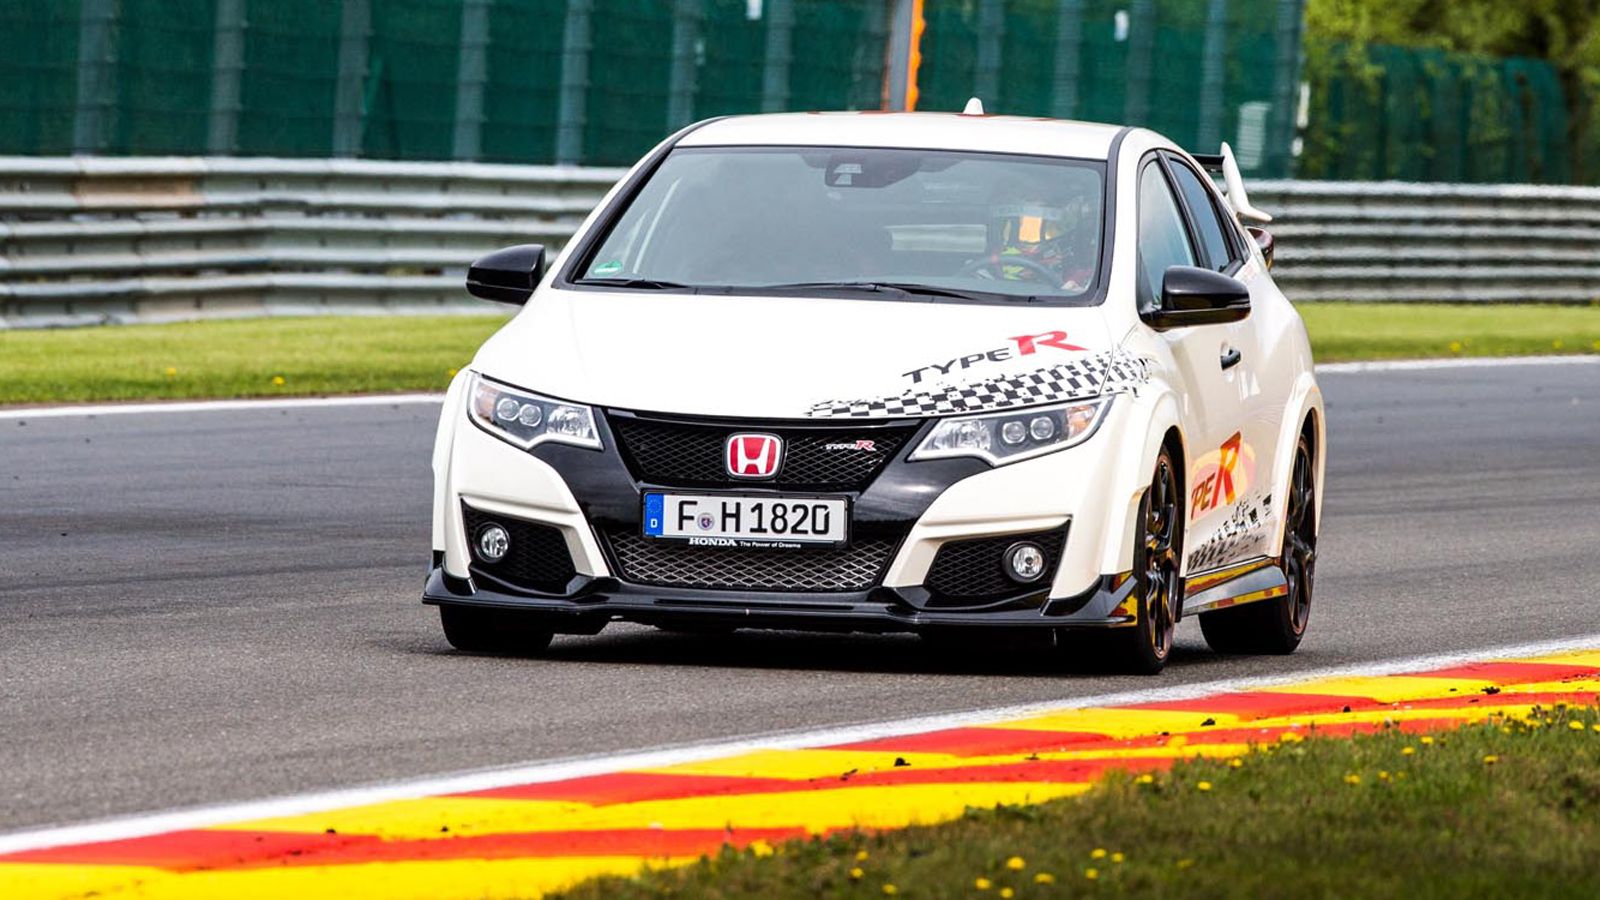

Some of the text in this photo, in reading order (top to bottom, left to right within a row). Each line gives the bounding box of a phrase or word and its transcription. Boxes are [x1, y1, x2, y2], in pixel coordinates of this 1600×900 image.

[902, 330, 1090, 384] TYPE R
[855, 439, 877, 451] R
[1210, 431, 1241, 509] R
[678, 500, 698, 531] F
[689, 537, 737, 547] HONDA
